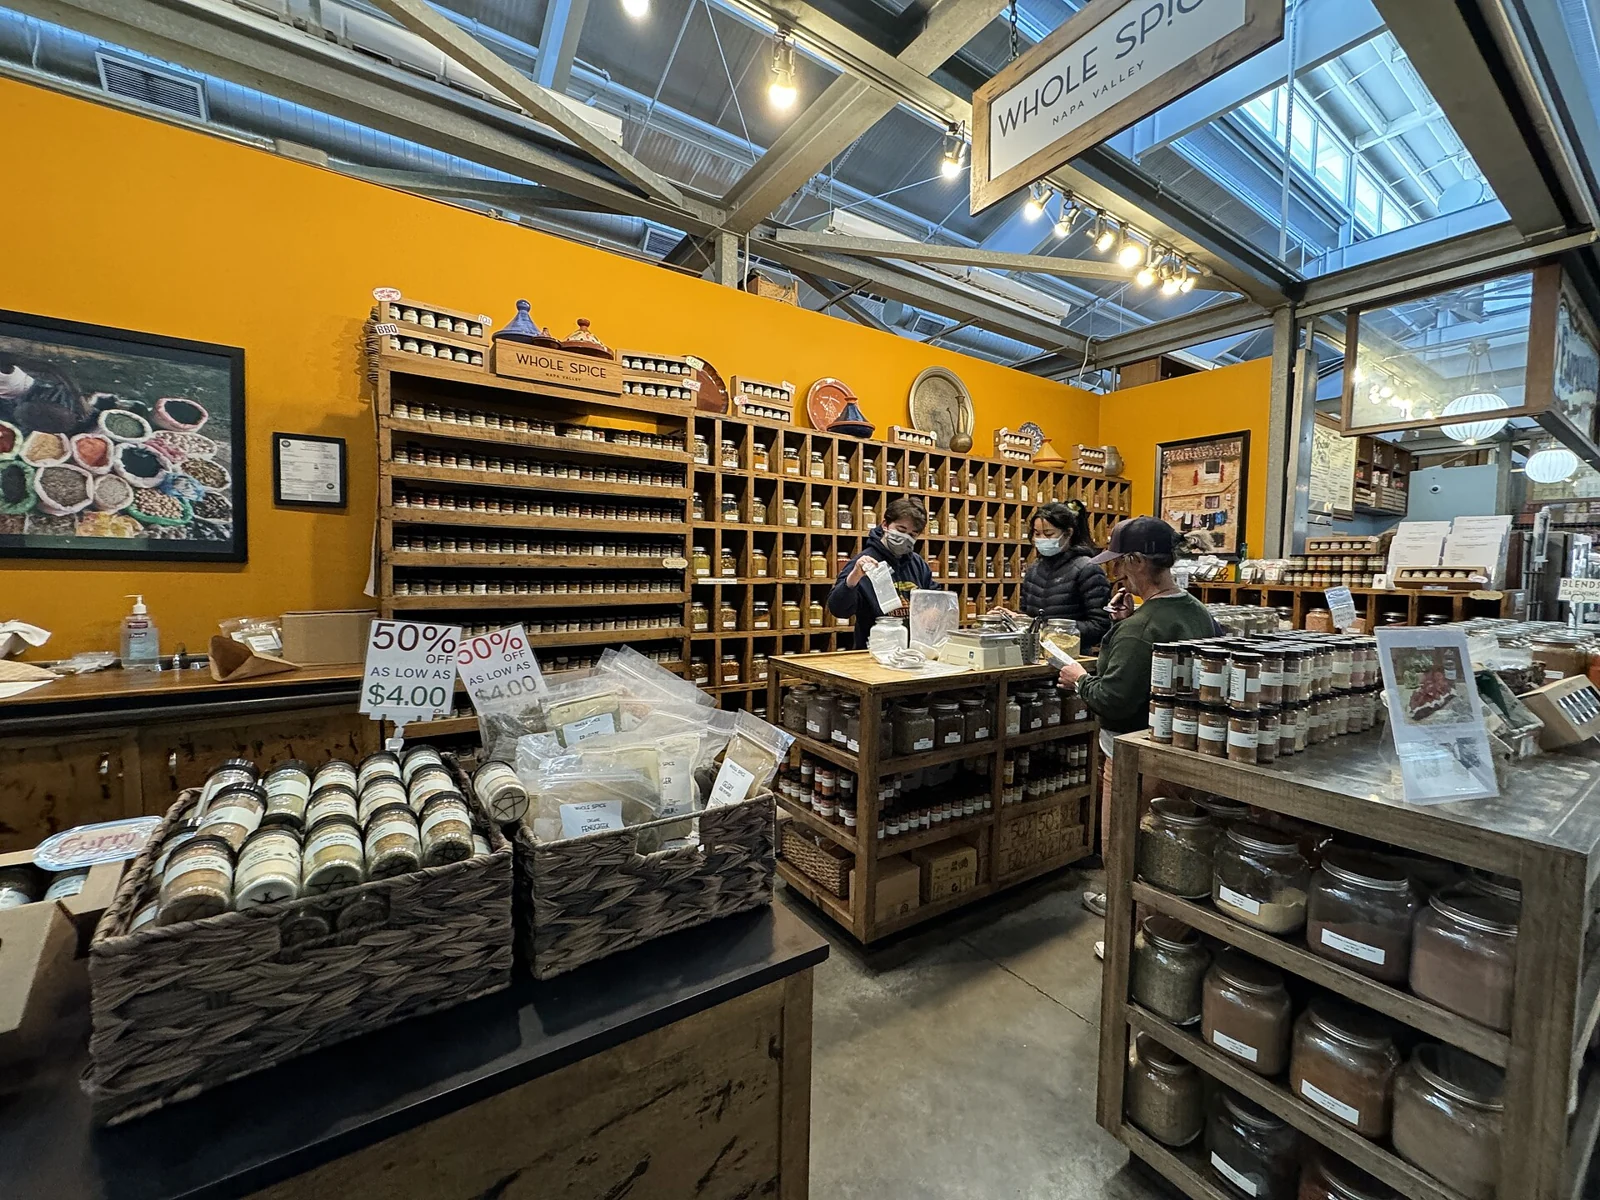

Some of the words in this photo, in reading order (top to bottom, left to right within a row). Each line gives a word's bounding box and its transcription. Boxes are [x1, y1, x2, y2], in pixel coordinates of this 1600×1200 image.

[998, 46, 1098, 137] WHOLE
[1052, 100, 1085, 126] NAPA
[1092, 60, 1144, 98] VALLEY
[376, 324, 398, 334] BBQ
[516, 353, 564, 372] WHOLE
[372, 622, 457, 654] 50%
[457, 629, 523, 665] 50%
[425, 654, 454, 665] OFF
[503, 649, 526, 663] OFF
[370, 666, 390, 677] AS
[395, 667, 429, 679] LOW
[432, 669, 451, 680] AS
[469, 675, 484, 686] AS
[487, 666, 512, 681] LOW
[516, 661, 531, 672] AS
[367, 682, 446, 707] $4.00
[475, 674, 537, 701] $4.00
